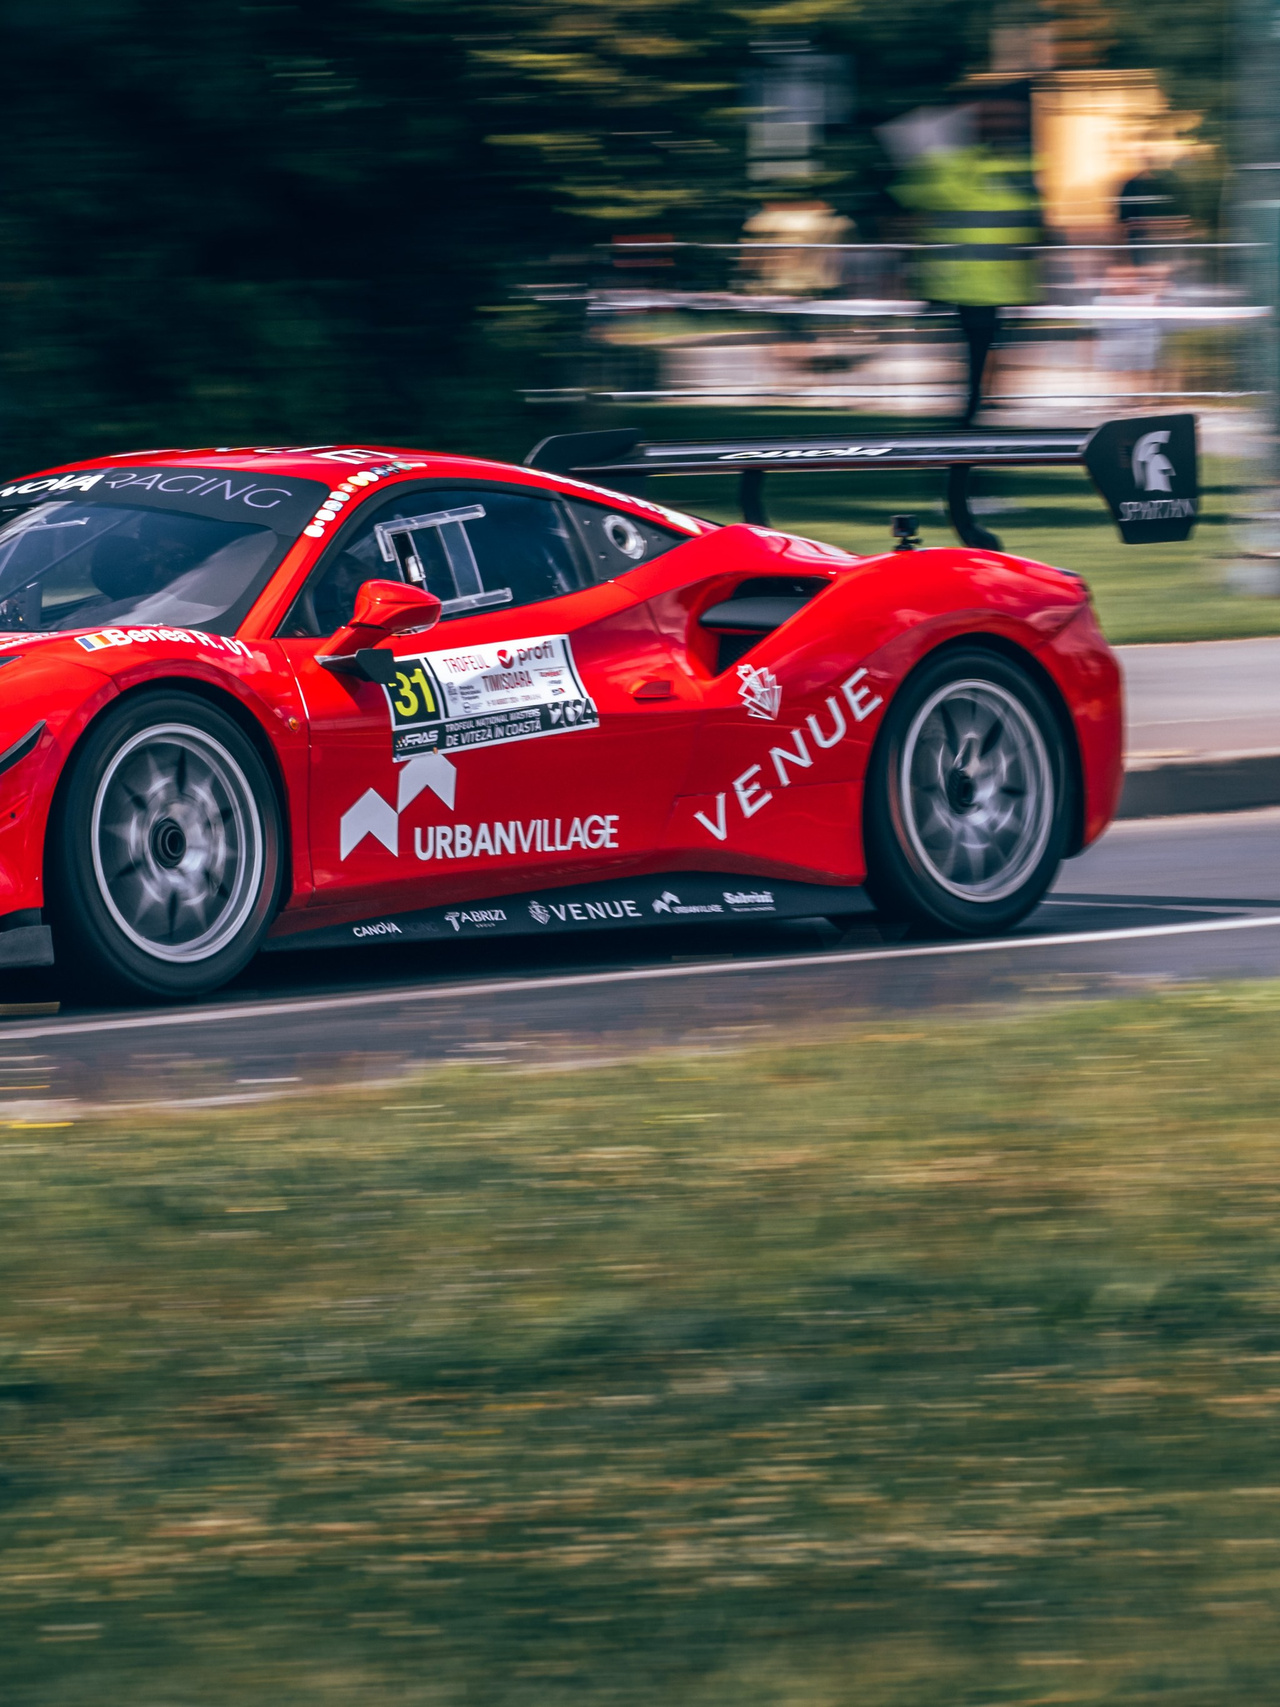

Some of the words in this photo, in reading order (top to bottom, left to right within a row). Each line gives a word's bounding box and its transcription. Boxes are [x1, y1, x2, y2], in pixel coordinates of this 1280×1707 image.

[105, 472, 292, 509] RACING
[101, 629, 196, 646] Benea
[187, 629, 225, 651] R.
[221, 636, 254, 659] 01
[442, 653, 491, 675] TROFEUL
[516, 640, 555, 666] profi
[387, 668, 437, 717] 31
[403, 730, 440, 747] FRAS
[445, 720, 475, 733] TROFEUL
[445, 733, 459, 747] DE
[505, 718, 542, 737] COASTĂ
[693, 667, 884, 841] VENUE
[414, 814, 619, 860] URBANVILLAGE
[548, 900, 642, 921] VENUE
[352, 921, 403, 938] CANOVA
